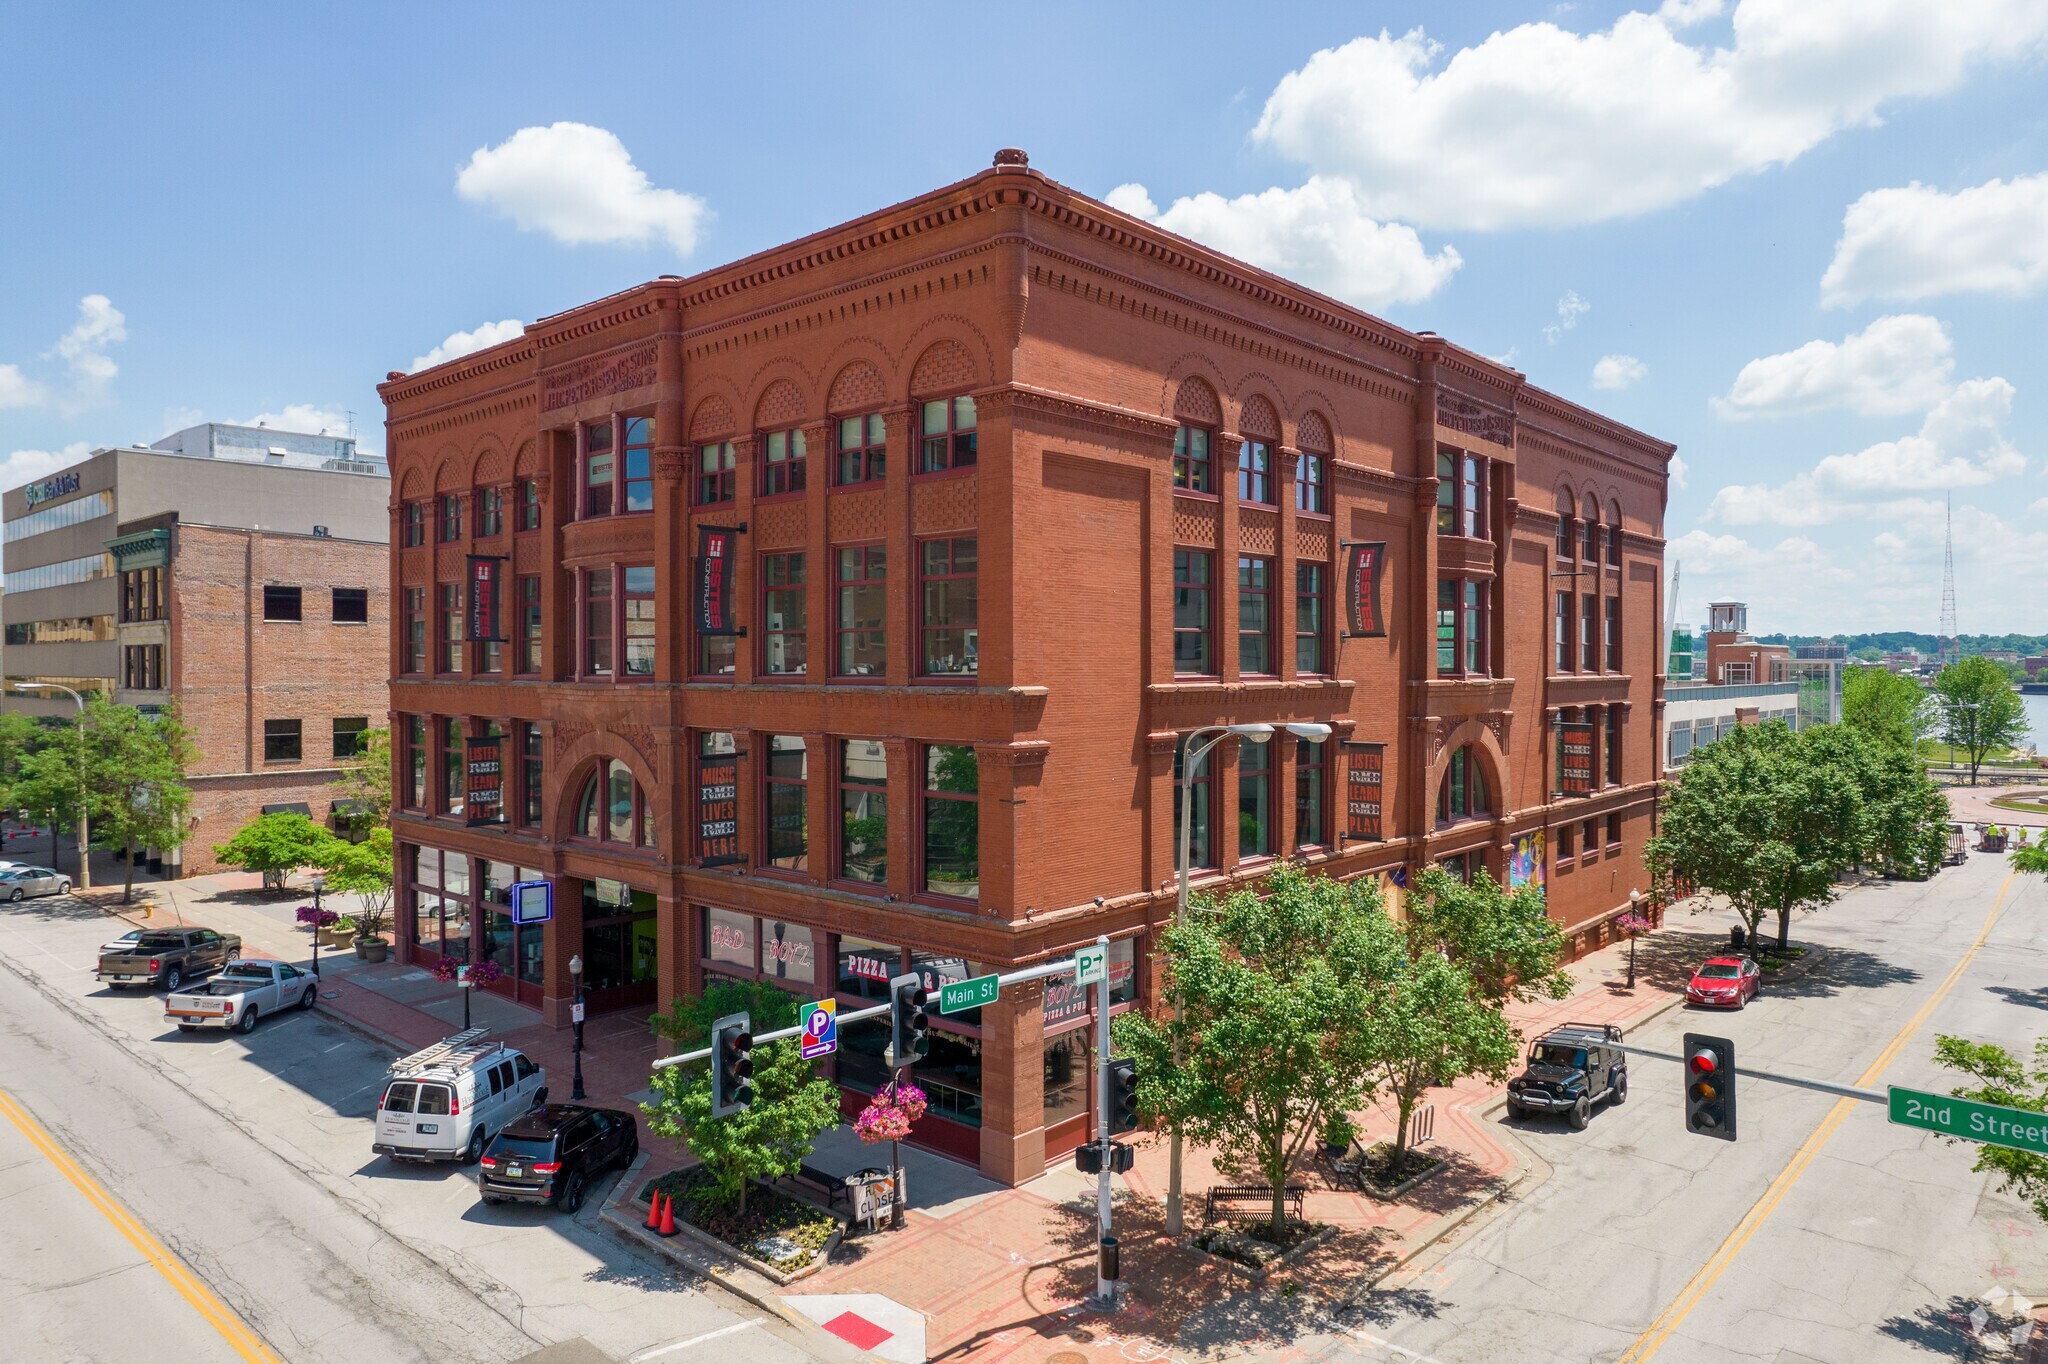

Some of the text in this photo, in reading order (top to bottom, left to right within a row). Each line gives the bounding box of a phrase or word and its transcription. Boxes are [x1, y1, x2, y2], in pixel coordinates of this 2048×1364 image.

[703, 557, 711, 629] CONSTRUCTION
[709, 558, 723, 629] ESTES
[1353, 569, 1363, 631] CONSTRUCTION
[1360, 569, 1375, 631] ESTES
[480, 581, 491, 637] ESTES
[1564, 731, 1590, 744] MUSIC
[469, 746, 499, 761] LISTEN
[1349, 753, 1381, 769] LISTEN
[1563, 755, 1590, 768] LIVES
[469, 774, 499, 790] LEARN
[702, 765, 735, 785] MUSIC
[1349, 770, 1381, 783] RME
[702, 785, 735, 800] RME
[1349, 784, 1381, 801] LEARN
[469, 803, 498, 819] PLAY
[702, 801, 735, 822] LIVES
[1349, 802, 1380, 815] RME
[702, 821, 735, 837] RME
[1349, 815, 1380, 833] PLAY
[703, 836, 736, 858] HERE
[711, 925, 745, 950] BAD
[848, 955, 889, 983] PIZZA
[924, 971, 934, 992] &
[947, 988, 974, 1006] Main
[981, 982, 994, 998] St
[1043, 1000, 1087, 1022] PIZZA & PUB
[1906, 1099, 2048, 1145] 2nd Street
